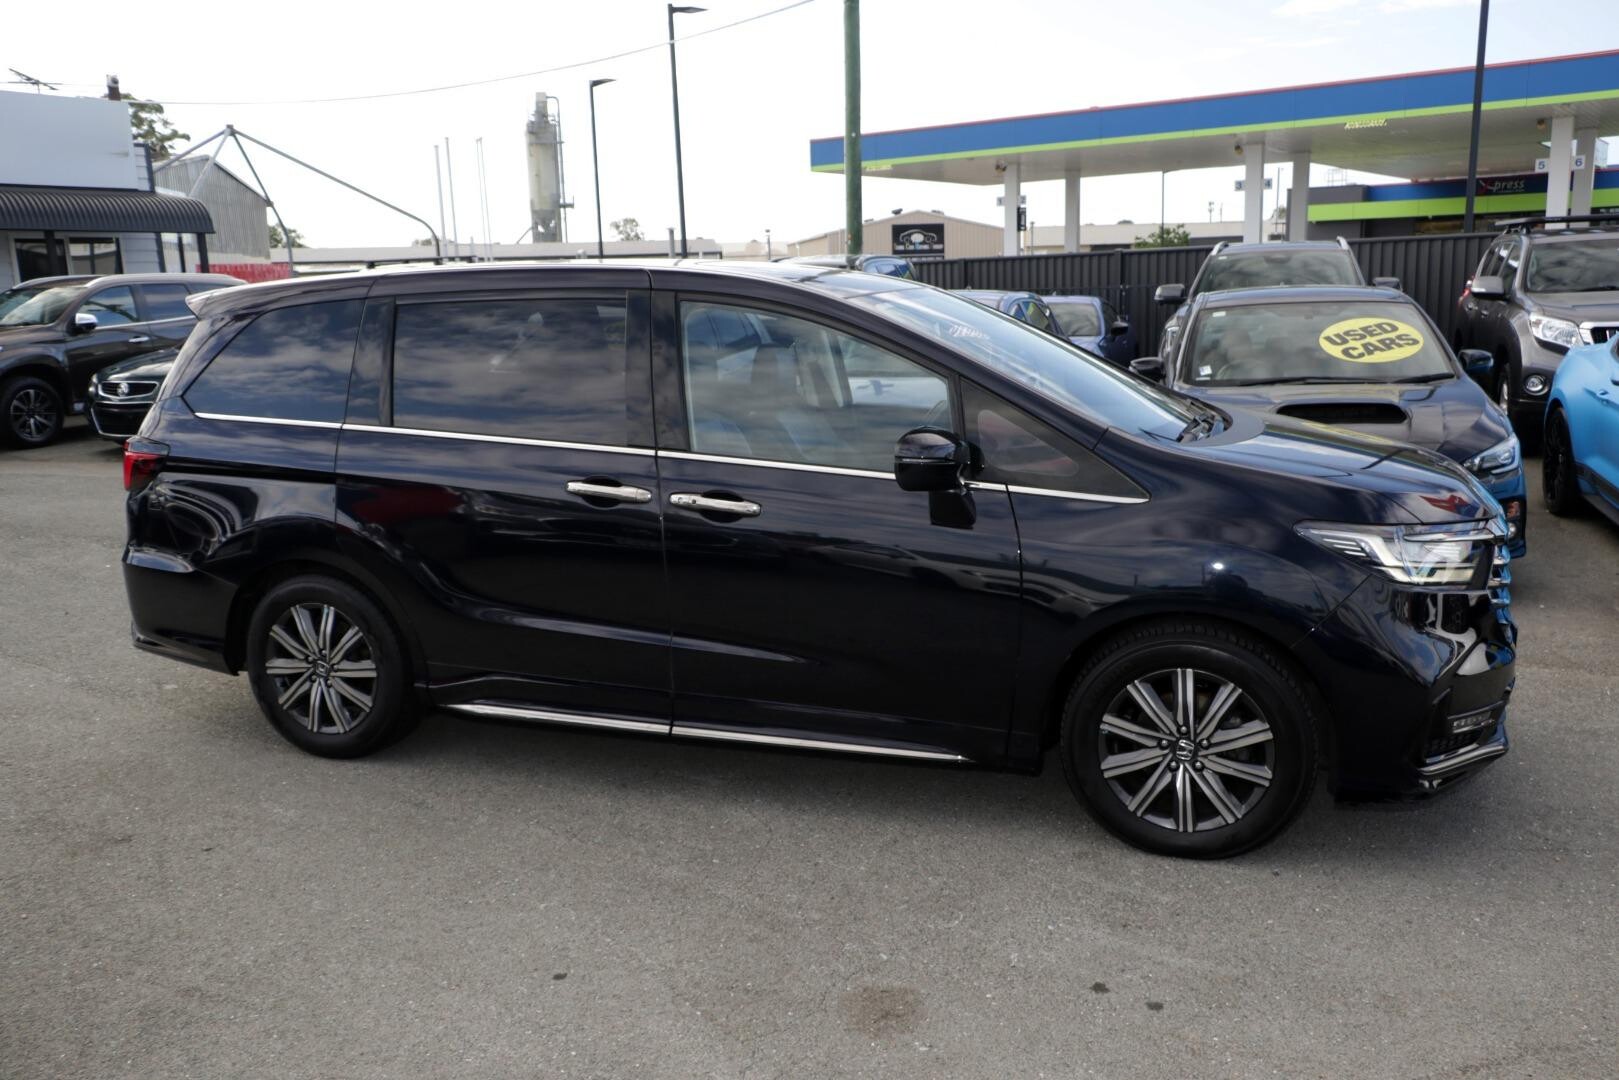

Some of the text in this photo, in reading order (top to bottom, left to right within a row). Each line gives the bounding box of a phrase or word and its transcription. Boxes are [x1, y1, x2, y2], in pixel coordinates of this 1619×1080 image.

[1538, 160, 1545, 170] 5
[1575, 158, 1583, 167] 6
[1323, 322, 1399, 345] USED
[1341, 333, 1420, 359] CARS
